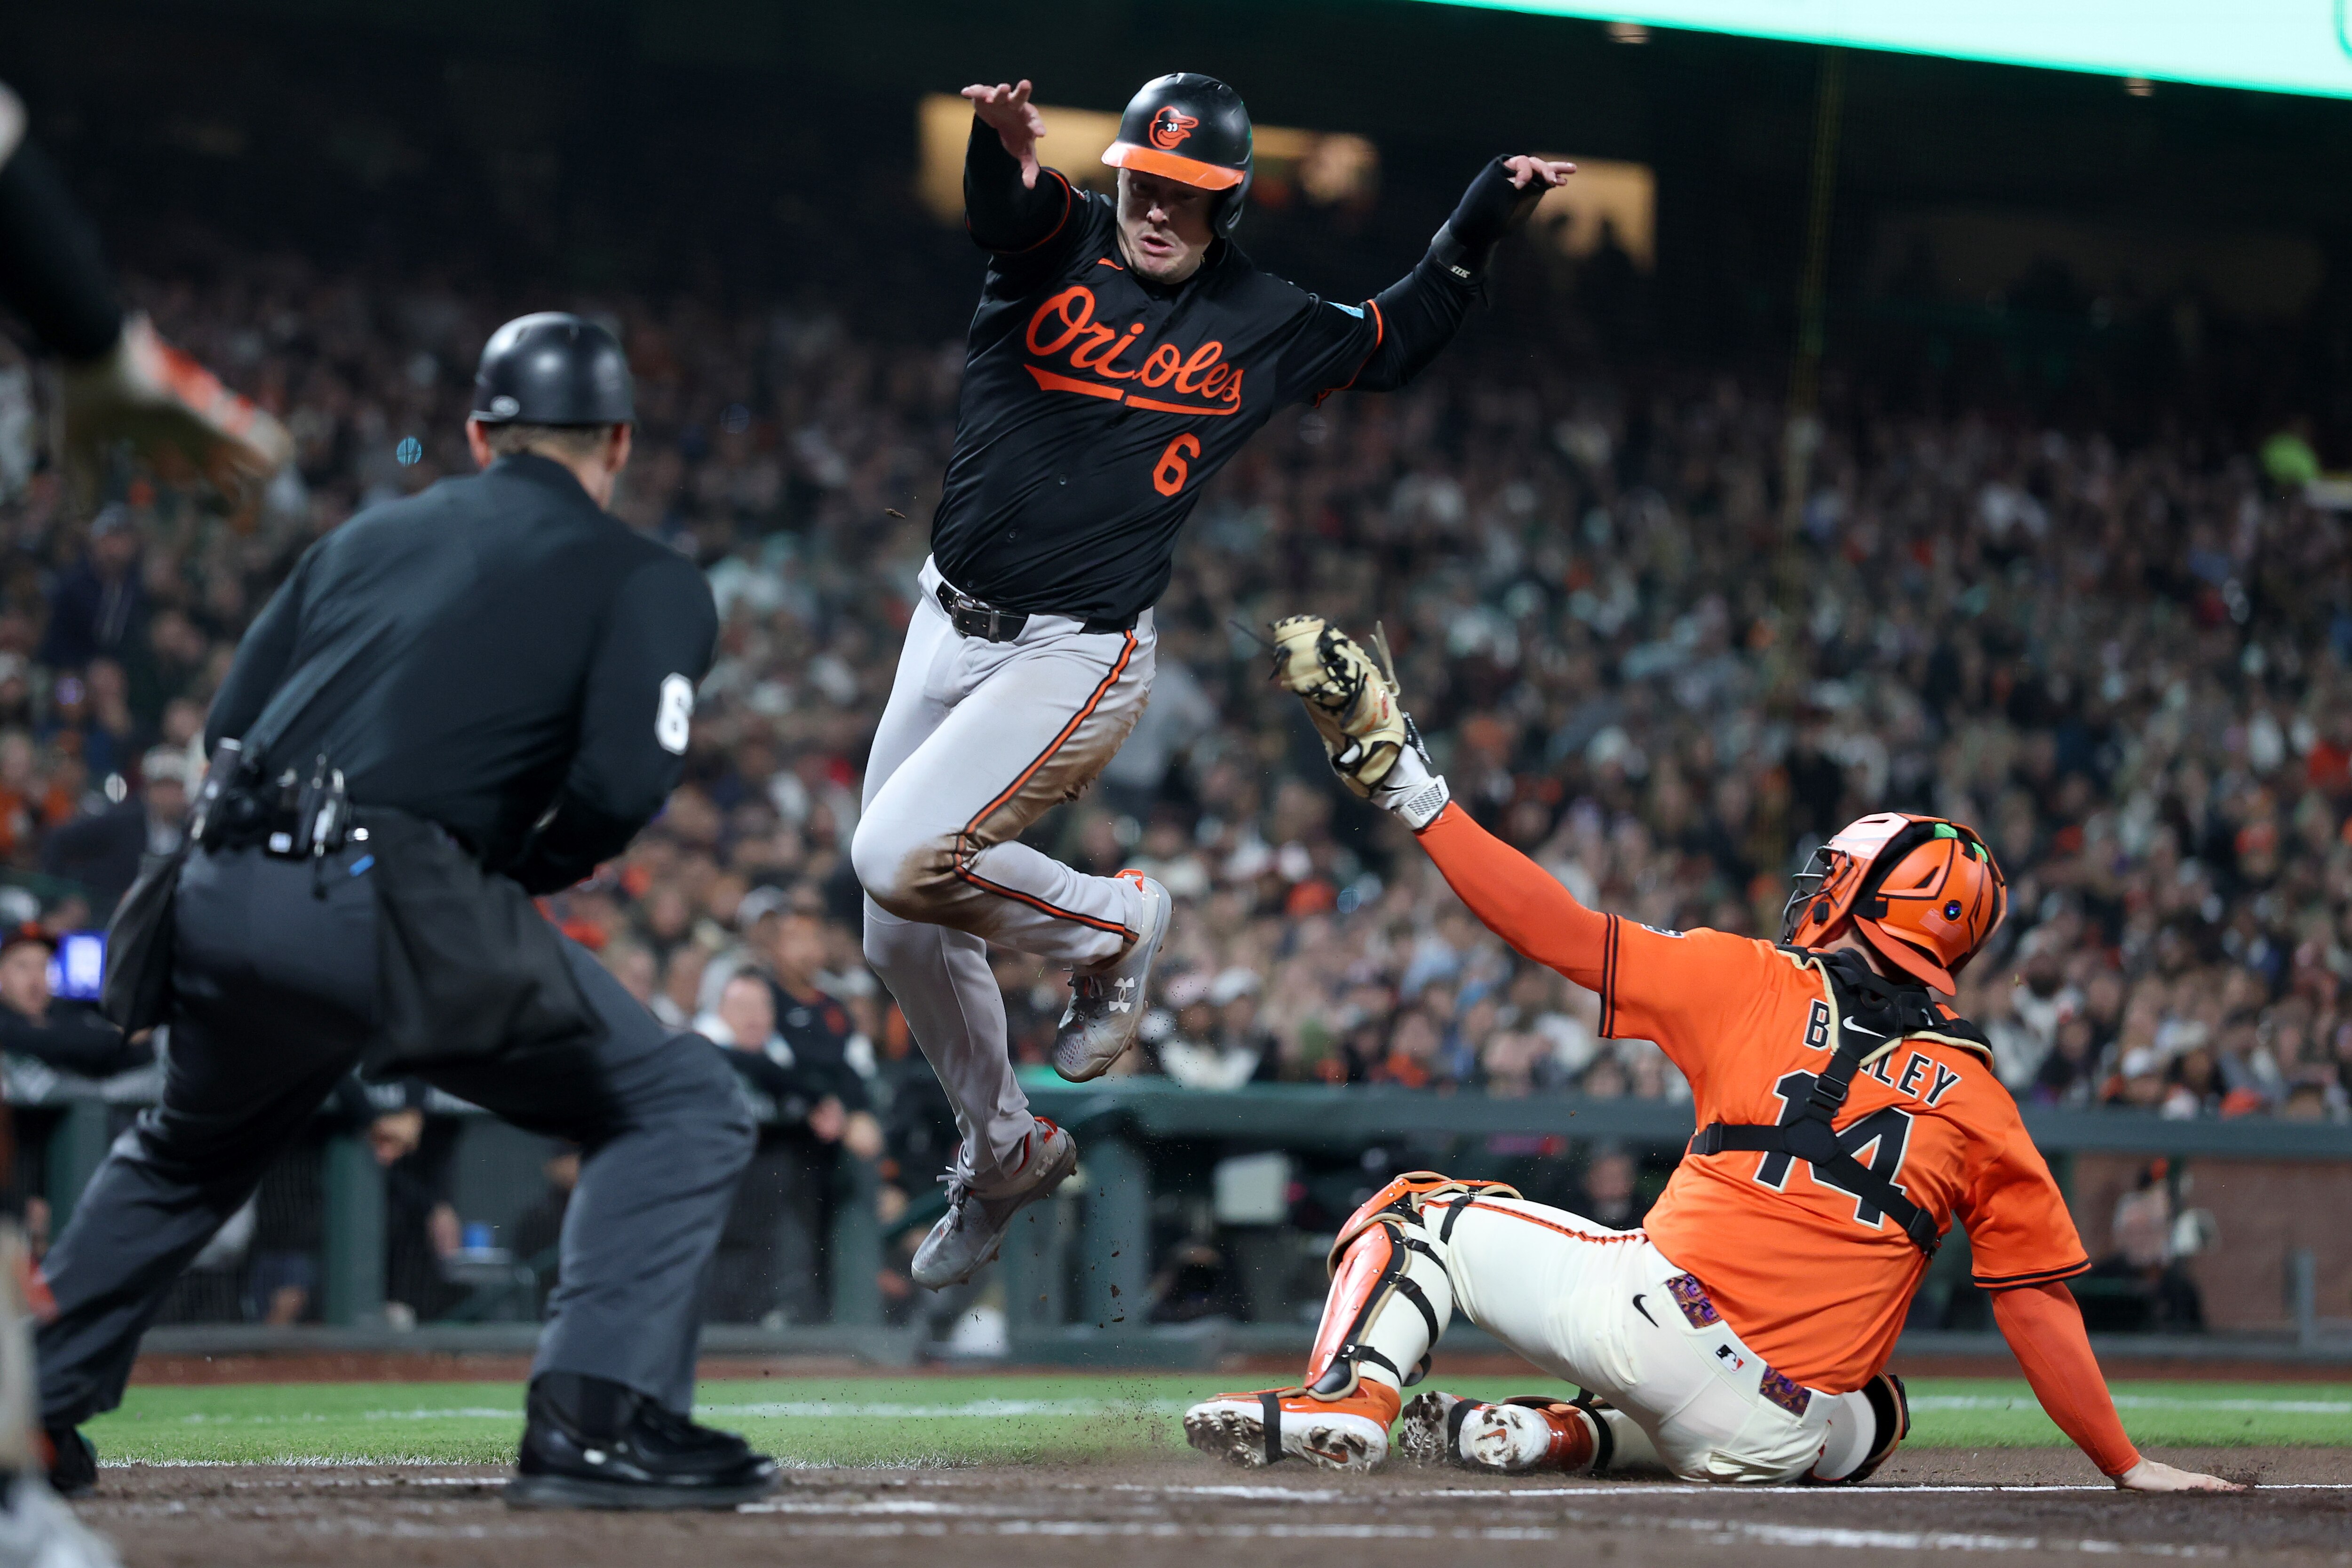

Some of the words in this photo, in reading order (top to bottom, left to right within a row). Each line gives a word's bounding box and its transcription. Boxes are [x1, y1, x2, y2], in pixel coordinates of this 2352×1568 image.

[1026, 285, 1244, 403] Orioles
[1152, 432, 1201, 497] 6
[656, 673, 693, 755] 6
[1803, 998, 1962, 1108] BLEY
[1753, 1068, 1914, 1231] 14
